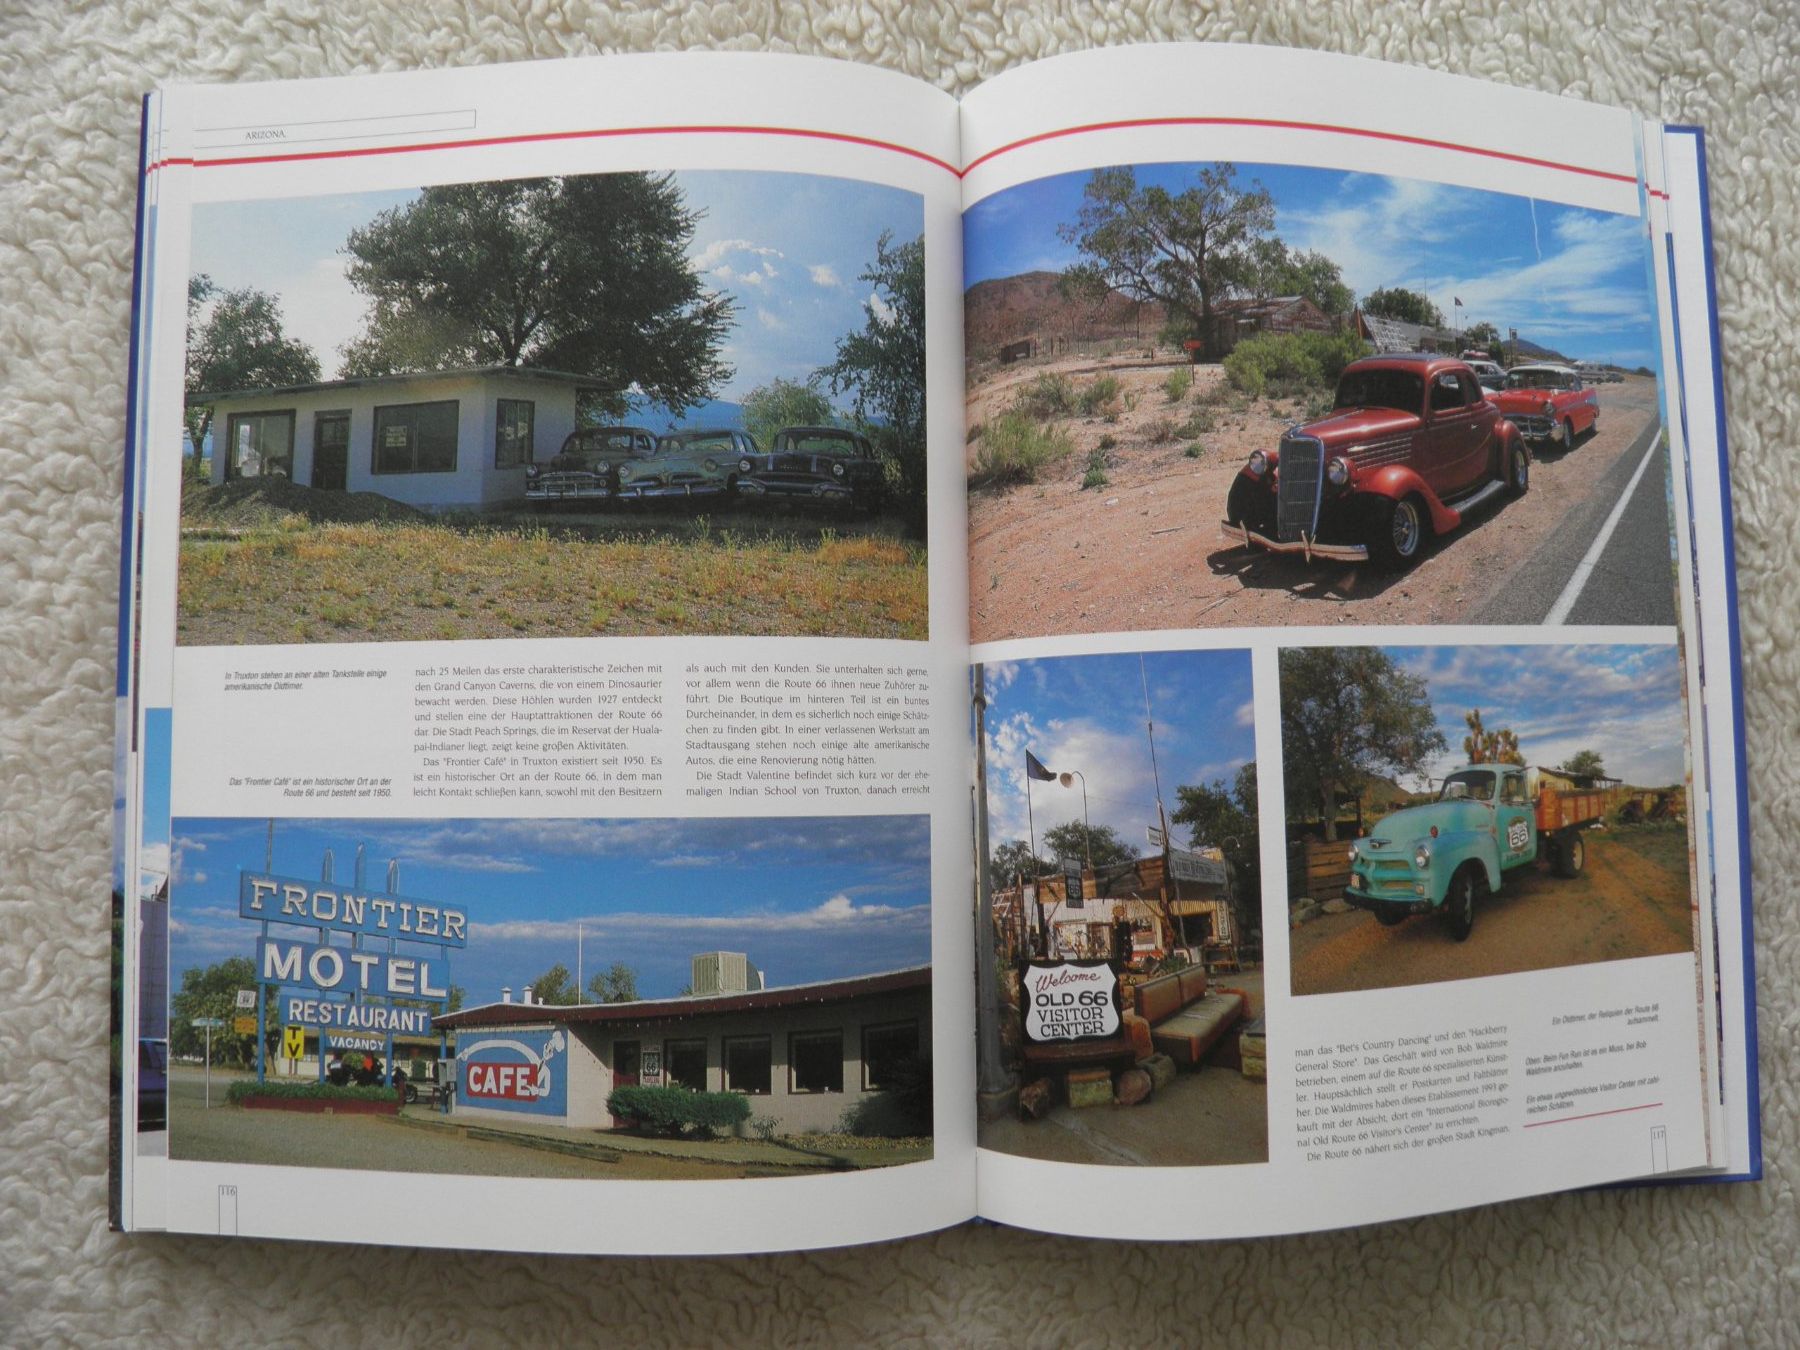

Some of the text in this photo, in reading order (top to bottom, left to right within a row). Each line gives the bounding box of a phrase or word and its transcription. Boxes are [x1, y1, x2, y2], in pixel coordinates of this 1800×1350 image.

[245, 130, 285, 140] ARIZONA
[233, 671, 259, 679] Truxton
[312, 670, 329, 678] alten
[365, 670, 387, 678] einige
[415, 664, 661, 676] nach 25 Meilen das erste charakteristische Zeichen mit
[414, 696, 449, 705] bewacht
[492, 695, 516, 705] Diese
[521, 695, 553, 704] Höhlen
[558, 695, 592, 704] wurden
[598, 695, 617, 704] 1927
[621, 695, 662, 704] entdeckt
[760, 709, 768, 718] in
[771, 709, 792, 718] dem
[808, 709, 850, 719] sicherlich
[853, 710, 874, 719] noch
[876, 710, 900, 722] einige
[902, 711, 930, 720] Schätz-
[413, 741, 464, 753] pai-Indianer
[491, 741, 512, 752] zeigt
[515, 741, 540, 750] keine
[542, 741, 574, 752] großen
[685, 740, 929, 751] Stadtausgang stehen noch einige alte amerikanische
[423, 757, 439, 766] Das
[510, 756, 518, 766] in
[522, 756, 557, 765] Truxton
[561, 756, 597, 765] existiert
[601, 756, 618, 765] seit
[650, 756, 662, 765] Es
[718, 756, 733, 765] die
[736, 756, 757, 765] eine
[760, 756, 820, 767] Renovierung
[821, 756, 844, 767] nötig
[356, 777, 368, 785] Ort
[696, 771, 712, 780] Die
[717, 771, 742, 780] Stadt
[747, 771, 790, 780] Valentine
[794, 770, 831, 780] befindet
[836, 770, 854, 779] sich
[859, 770, 876, 779] kurz
[897, 770, 909, 779] der
[914, 770, 930, 779] ehe-
[413, 787, 435, 796] leicht
[439, 787, 472, 796] Kontakt
[474, 787, 516, 798] schließen
[545, 787, 577, 796] sowohl
[580, 787, 594, 796] mit
[598, 787, 615, 796] den
[618, 786, 661, 796] Besitzern
[686, 786, 722, 797] maligen
[729, 786, 758, 795] Indian
[764, 786, 796, 795] School
[867, 785, 896, 794] danach
[901, 785, 929, 794] erreicht
[250, 878, 465, 941] FRONTIER
[263, 943, 447, 998] MOTEL
[1035, 971, 1102, 993] Welcome
[1036, 991, 1108, 1007] OLD 66
[288, 998, 429, 1033] RESTAURANT
[1037, 1007, 1104, 1022] VISITOR
[1040, 1021, 1105, 1038] CENTER
[328, 1036, 385, 1052] VACANCY
[1362, 1037, 1394, 1051] Country
[468, 1065, 533, 1098] CAFE
